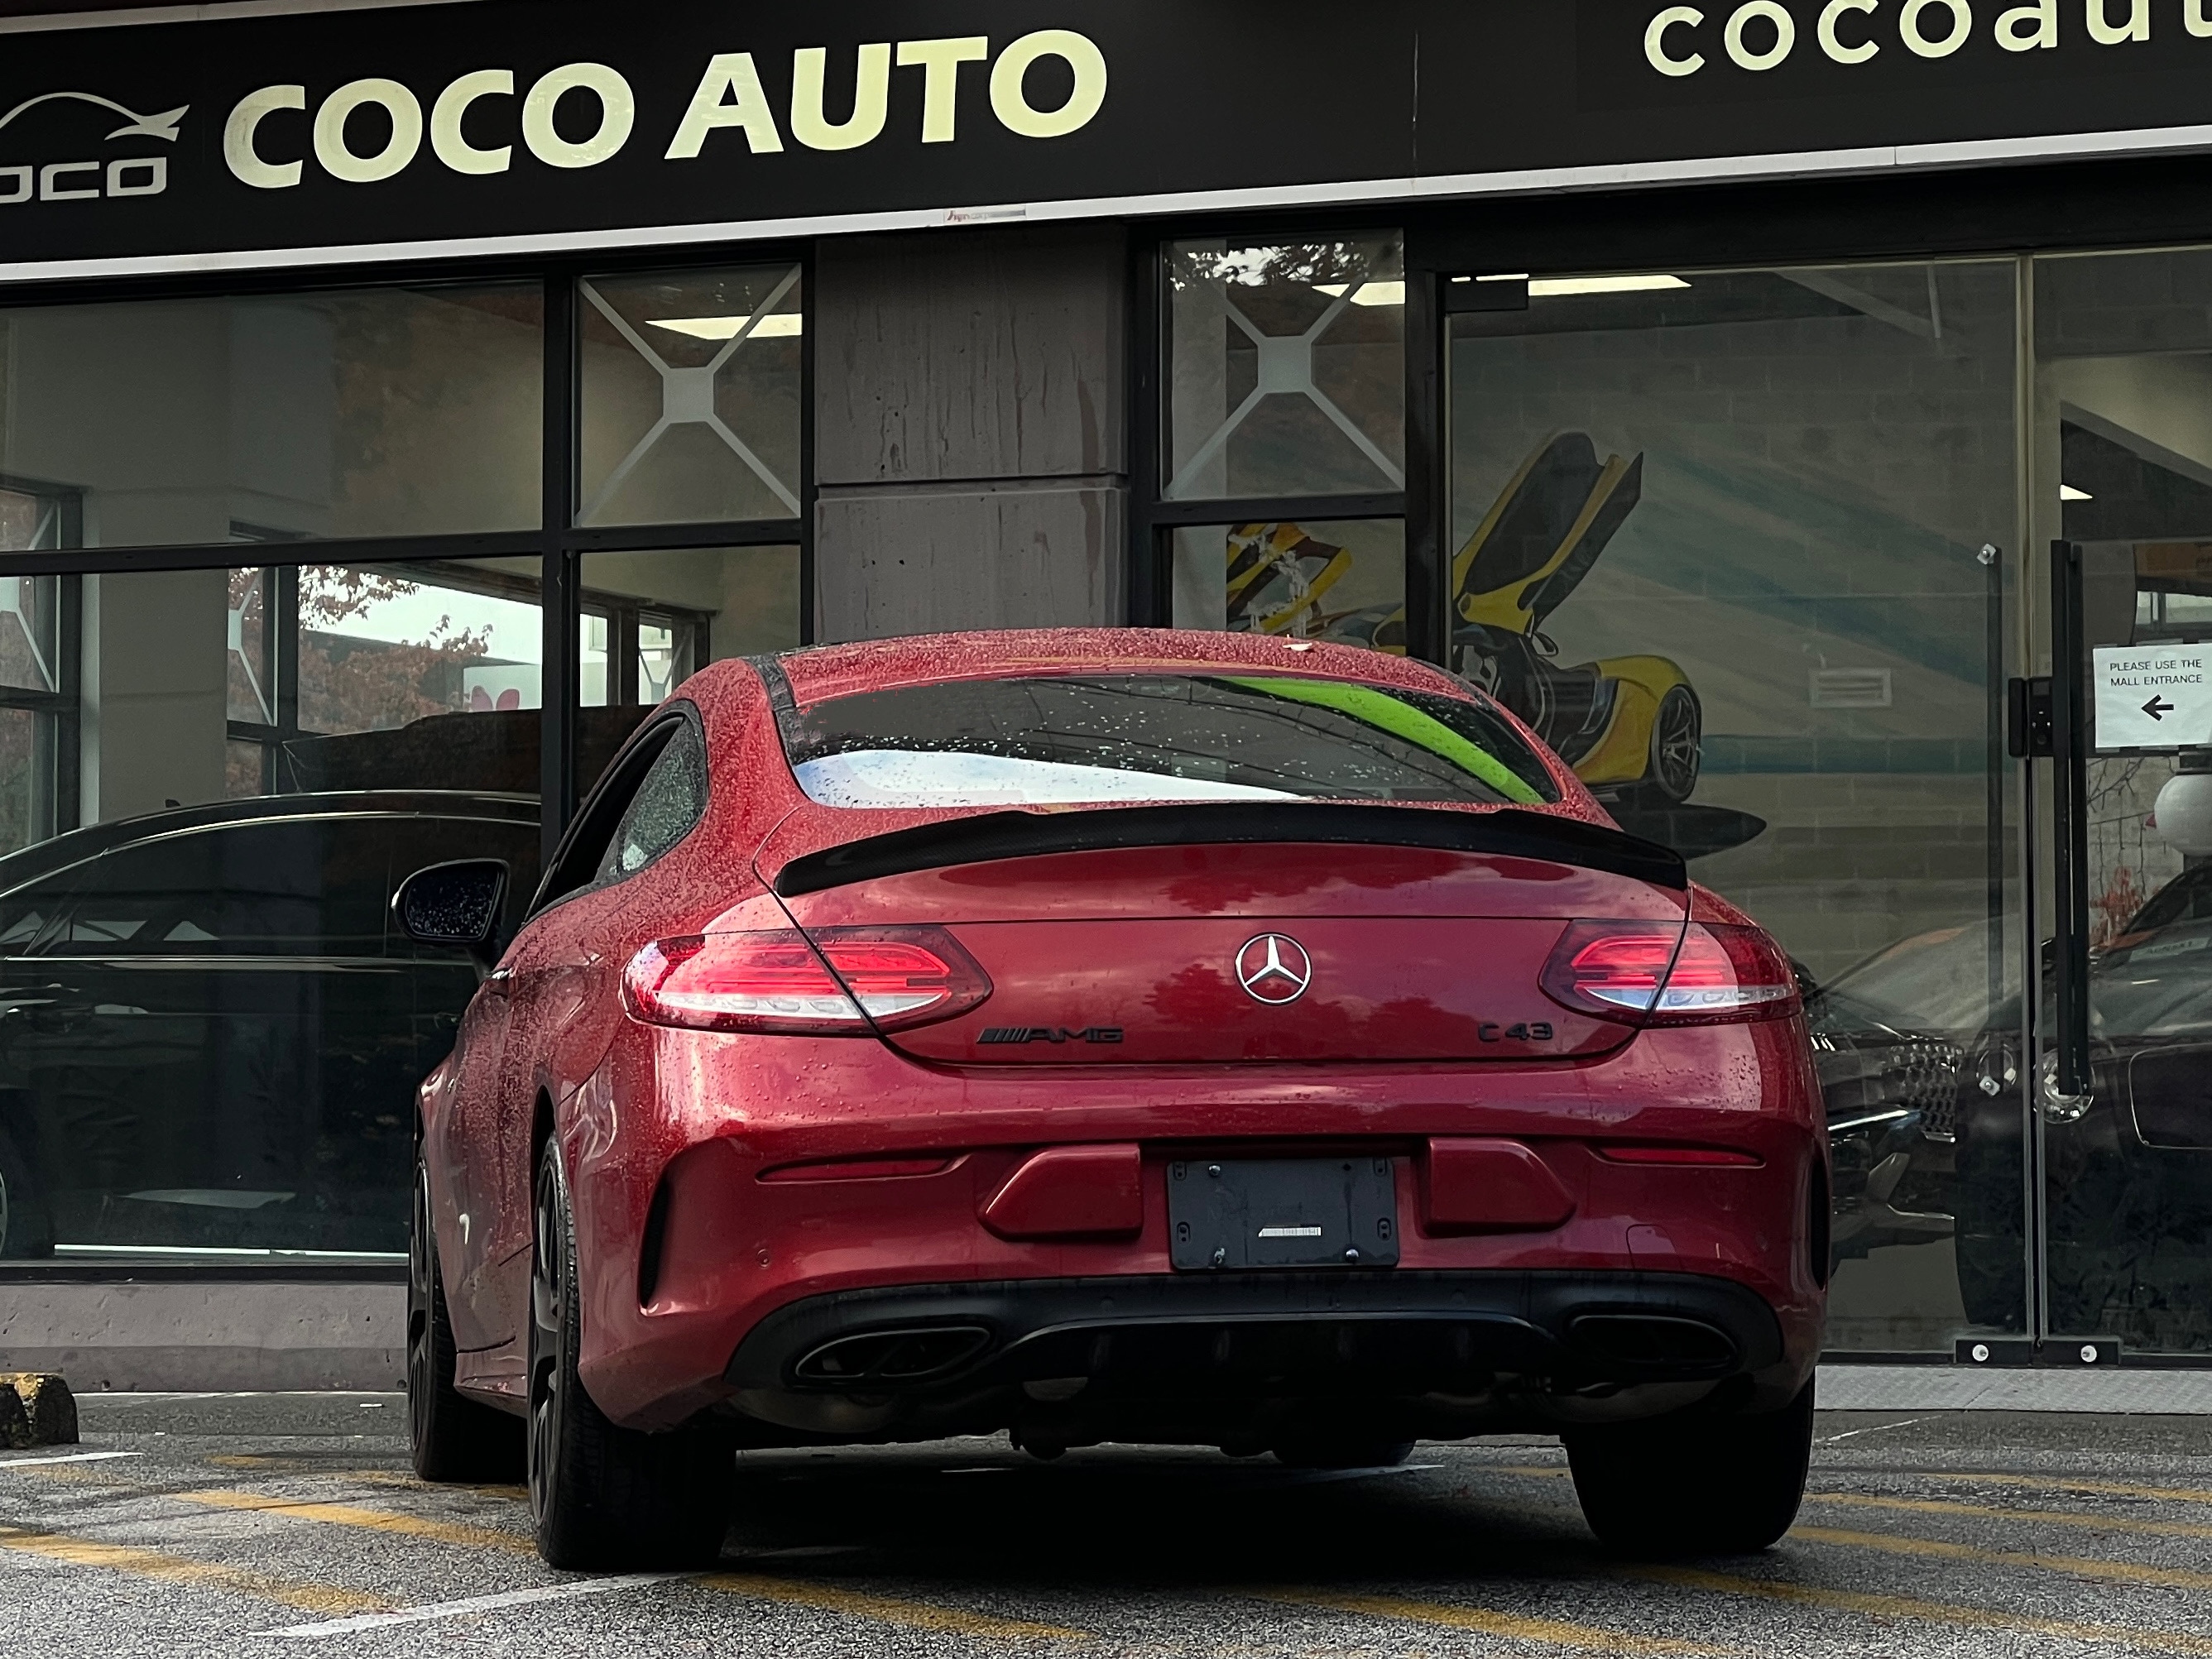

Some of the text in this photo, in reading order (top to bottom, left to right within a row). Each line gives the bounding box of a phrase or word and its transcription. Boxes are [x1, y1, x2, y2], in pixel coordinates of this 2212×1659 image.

[223, 29, 1107, 189] COCO AUTO
[2109, 659, 2203, 672] PLEASE USE THE
[2110, 674, 2203, 687] MALL ENTRANCE
[1023, 1026, 1125, 1044] AMG
